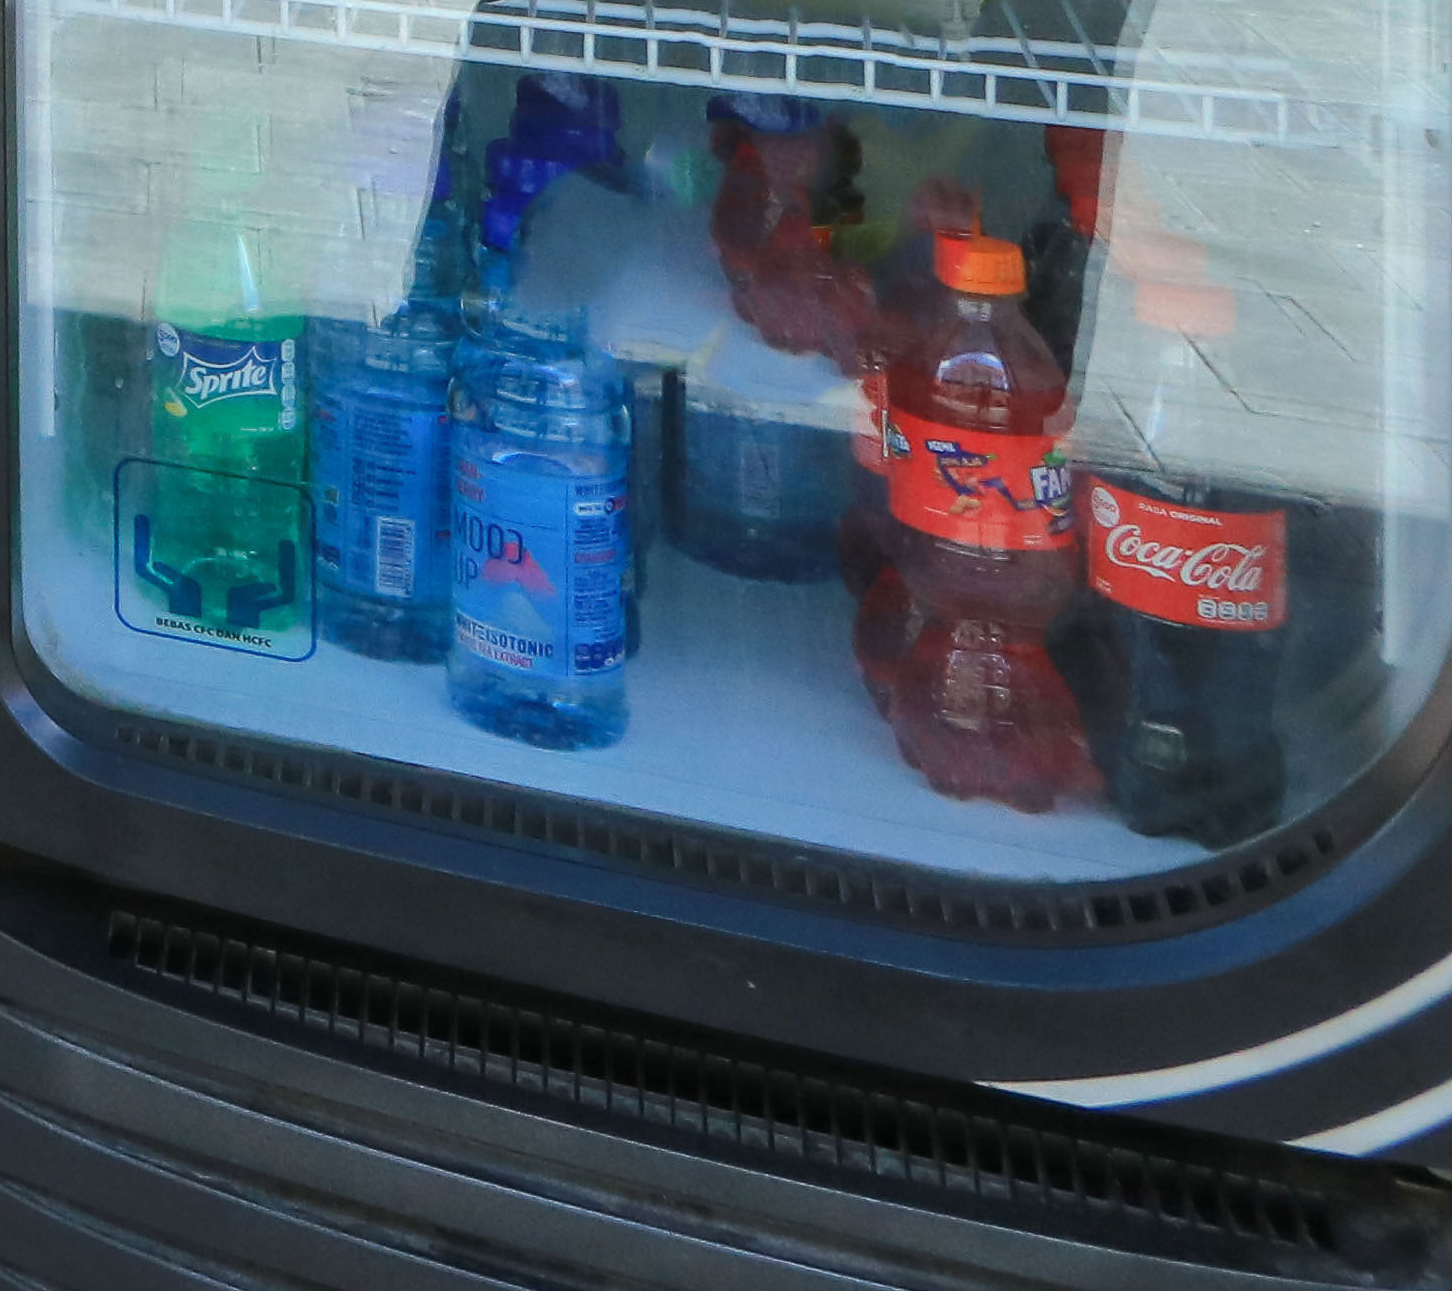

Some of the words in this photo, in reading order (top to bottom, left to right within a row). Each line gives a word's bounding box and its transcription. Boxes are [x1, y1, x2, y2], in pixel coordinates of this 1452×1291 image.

[184, 359, 267, 400] Sprite
[1106, 523, 1268, 594] Coca-Cola
[155, 617, 191, 631] BEBAS
[193, 624, 216, 637] CFC
[216, 628, 241, 642] DAN
[243, 635, 273, 649] HCFC
